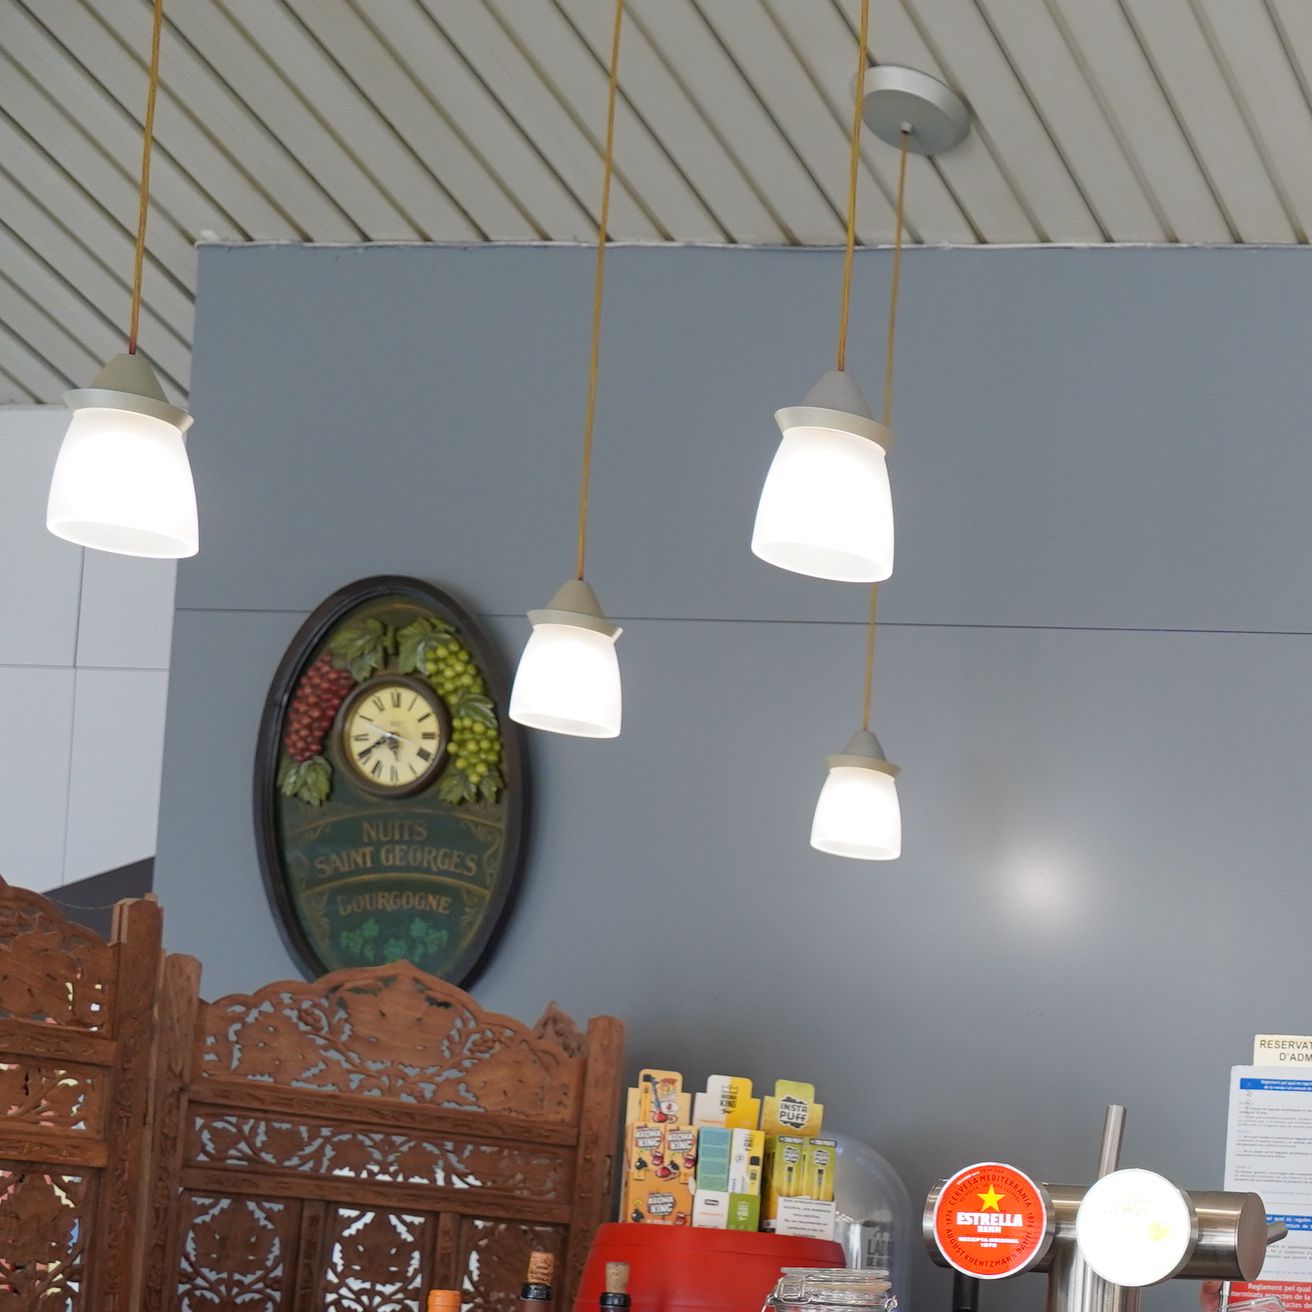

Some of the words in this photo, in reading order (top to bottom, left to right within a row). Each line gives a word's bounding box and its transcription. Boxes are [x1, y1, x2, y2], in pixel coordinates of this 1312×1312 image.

[362, 820, 428, 842] NUITS
[315, 845, 375, 876] SAINT
[381, 844, 478, 877] GEORGES
[780, 1101, 808, 1113] INSTA
[779, 1111, 808, 1122] PUFF
[957, 1212, 1023, 1227] ESTRELLA
[945, 1228, 966, 1257] AUGUST
